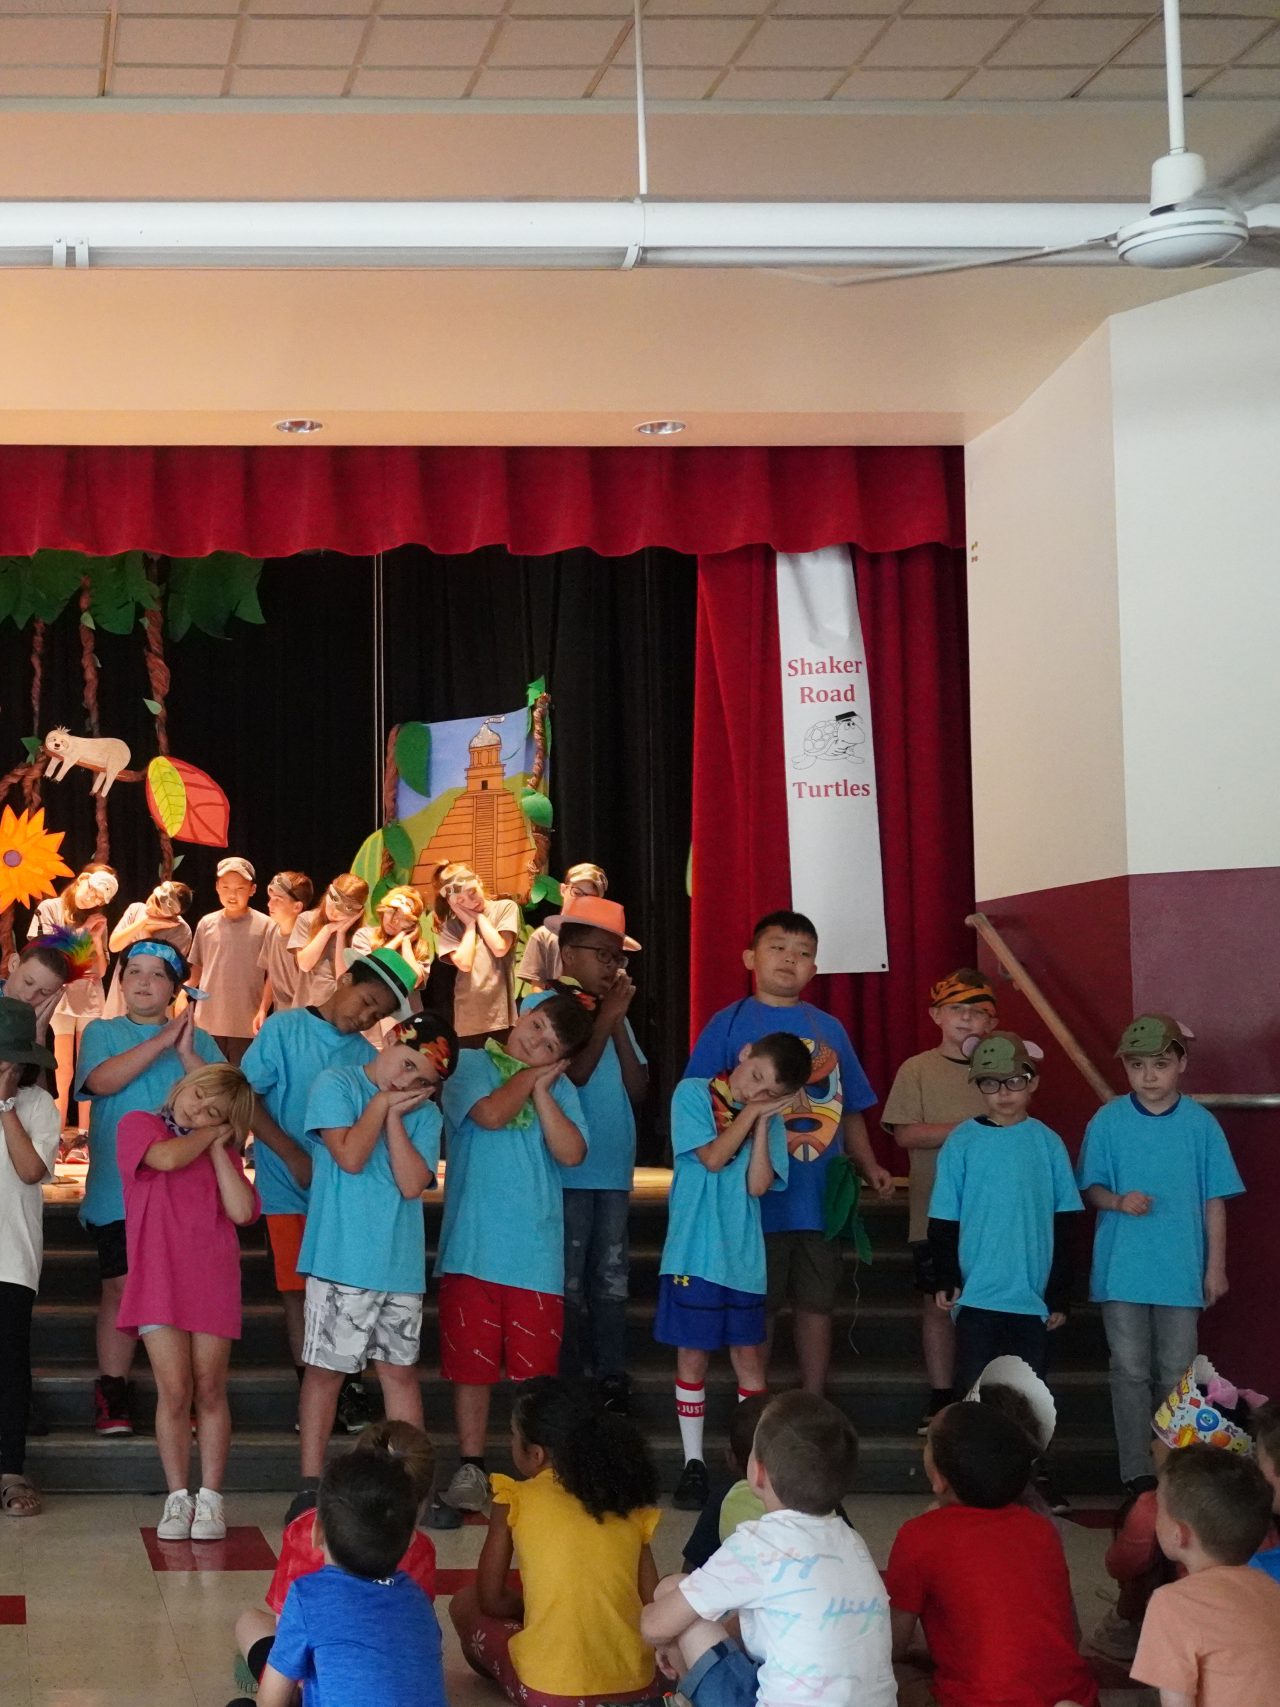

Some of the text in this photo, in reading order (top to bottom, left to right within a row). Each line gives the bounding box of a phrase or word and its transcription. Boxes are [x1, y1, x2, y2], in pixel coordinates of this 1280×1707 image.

[787, 655, 863, 677] Shaker
[799, 684, 856, 704] Road
[792, 779, 871, 799] Turtles
[681, 1403, 705, 1415] JUST
